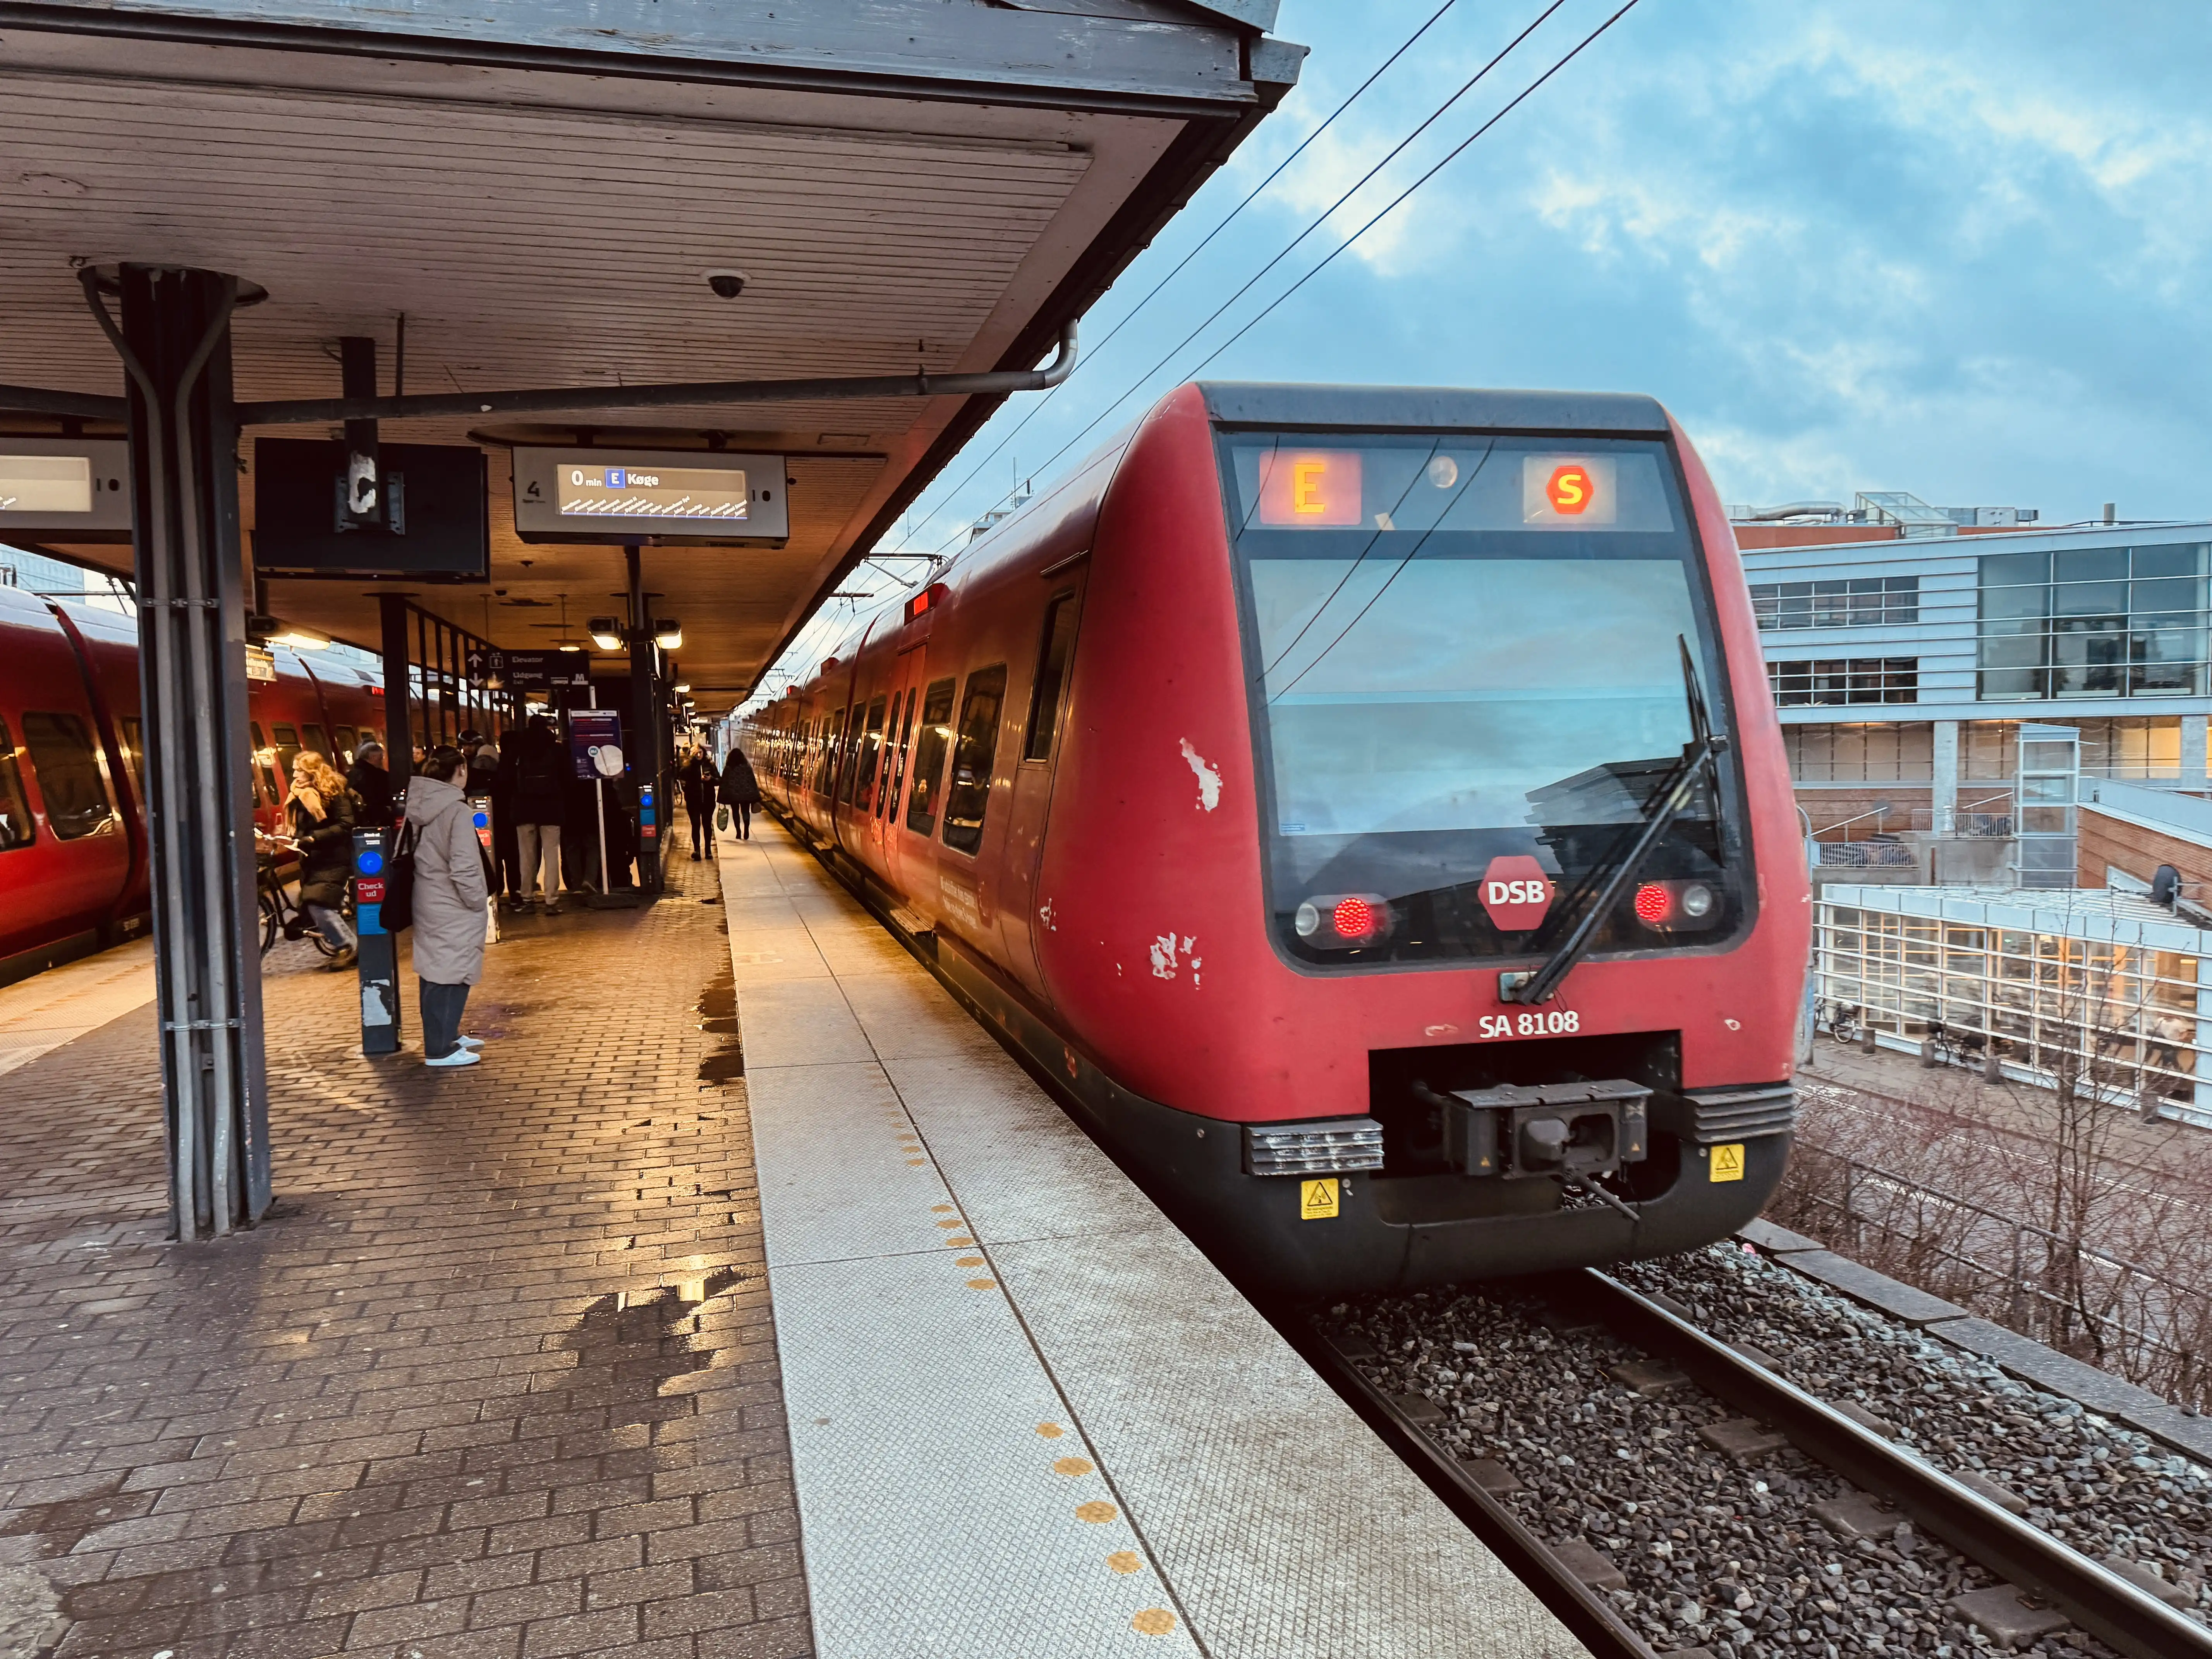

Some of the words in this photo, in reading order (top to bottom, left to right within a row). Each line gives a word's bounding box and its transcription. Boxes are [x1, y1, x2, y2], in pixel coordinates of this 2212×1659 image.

[527, 481, 540, 497] 4
[571, 470, 584, 486] 0
[586, 478, 602, 487] min
[611, 472, 620, 484] E
[627, 473, 659, 487] Køge
[1294, 463, 1326, 514] E
[1557, 474, 1583, 505] S
[358, 882, 384, 890] Check
[1488, 880, 1545, 905] DSB
[1479, 1015, 1513, 1038] SA
[1518, 1010, 1579, 1035] 8108
